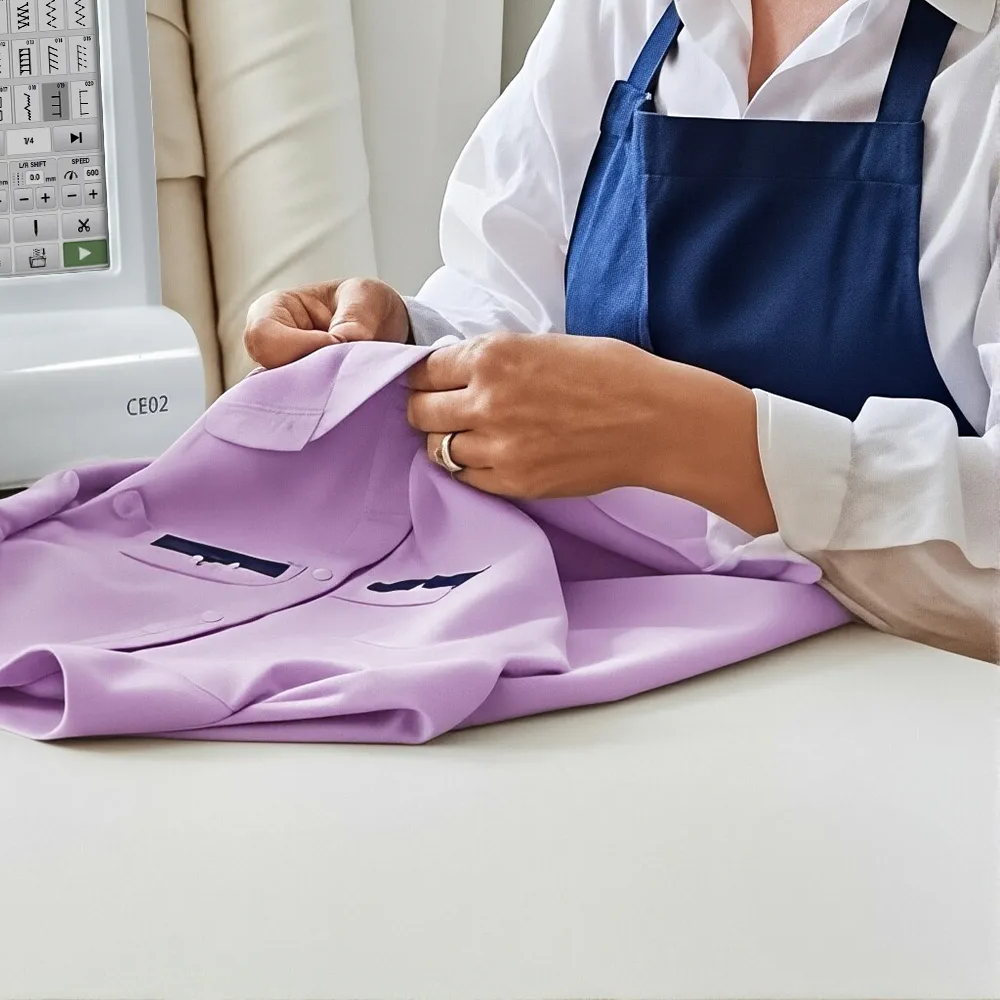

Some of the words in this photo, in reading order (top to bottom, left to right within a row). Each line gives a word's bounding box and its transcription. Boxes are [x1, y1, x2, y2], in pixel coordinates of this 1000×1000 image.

[18, 161, 29, 169] L/R
[30, 160, 47, 168] SHIFT
[71, 157, 90, 165] SPEED
[29, 173, 40, 181] 0.0
[86, 168, 99, 177] 600
[126, 395, 168, 416] CE02
